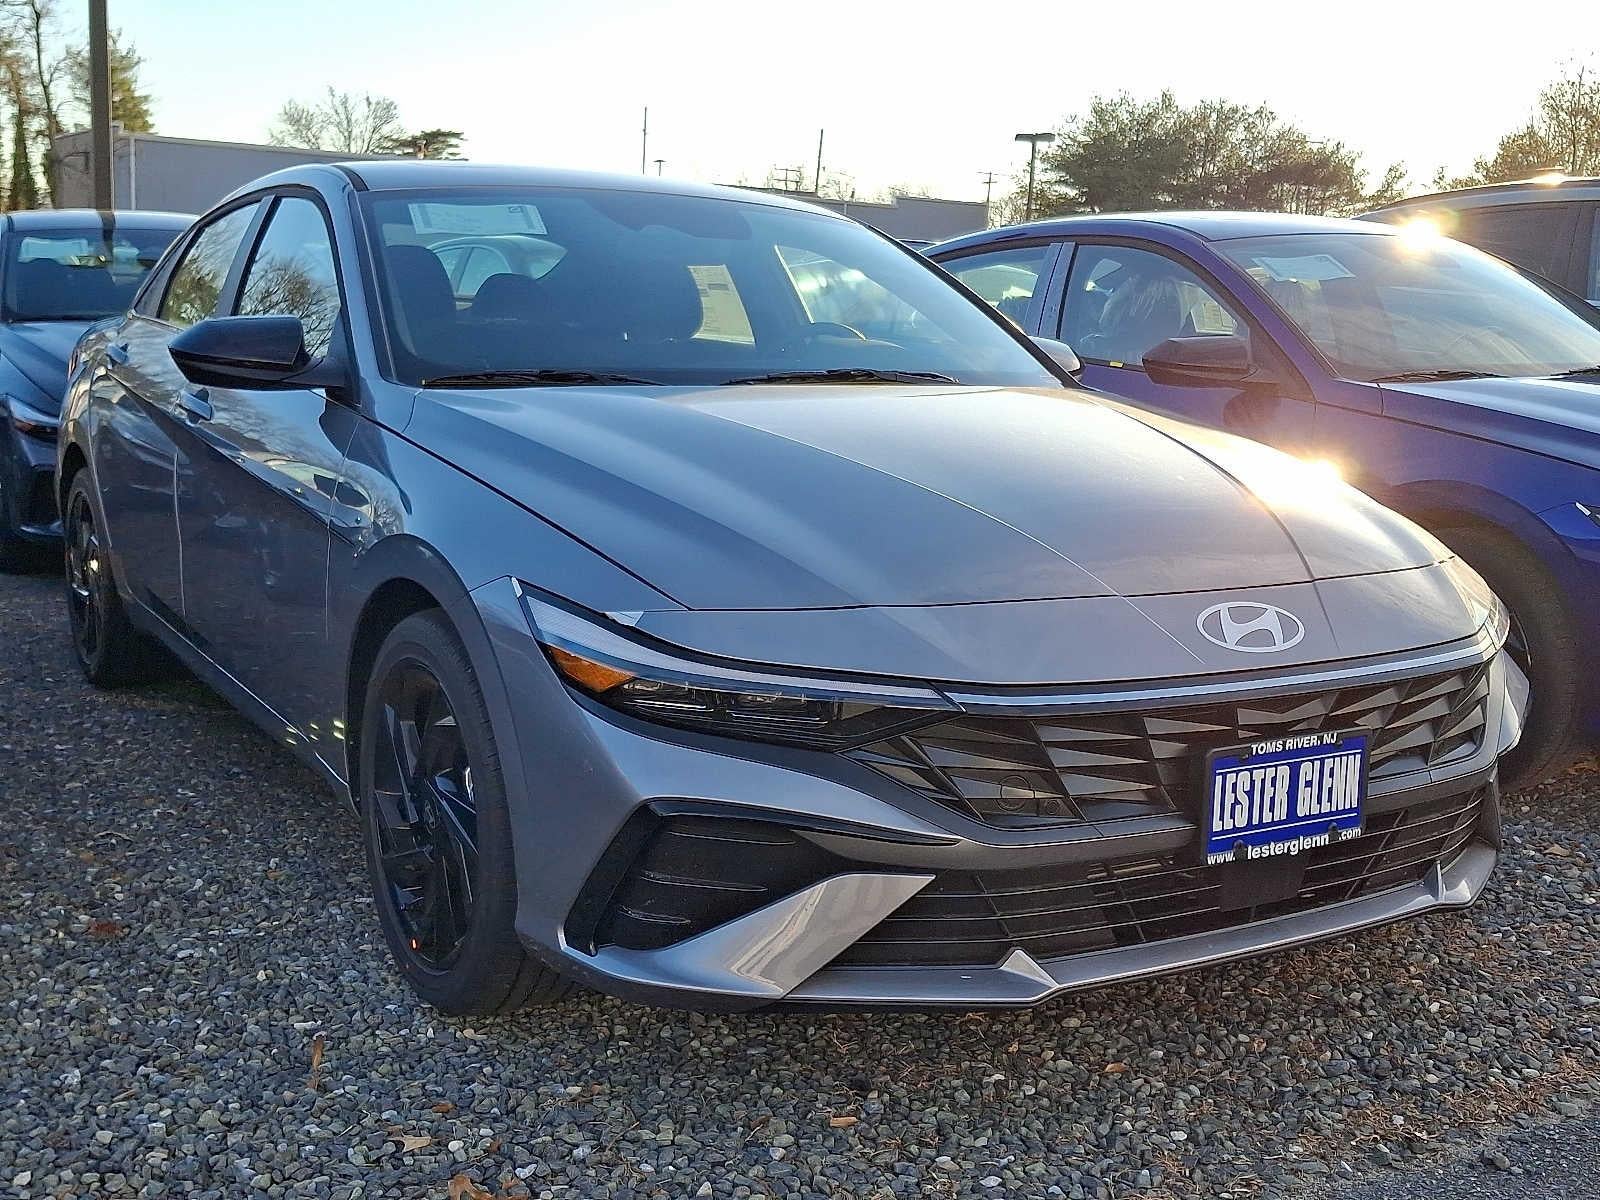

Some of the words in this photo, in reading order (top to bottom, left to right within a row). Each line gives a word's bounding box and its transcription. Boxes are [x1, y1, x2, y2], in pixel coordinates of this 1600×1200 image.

[1251, 741, 1283, 756] TOMS
[1323, 732, 1338, 745] NJ
[1212, 765, 1290, 832] LESTER
[1296, 754, 1361, 817] GLENN
[1207, 852, 1236, 865] www.
[1248, 834, 1329, 860] lesterglenn
